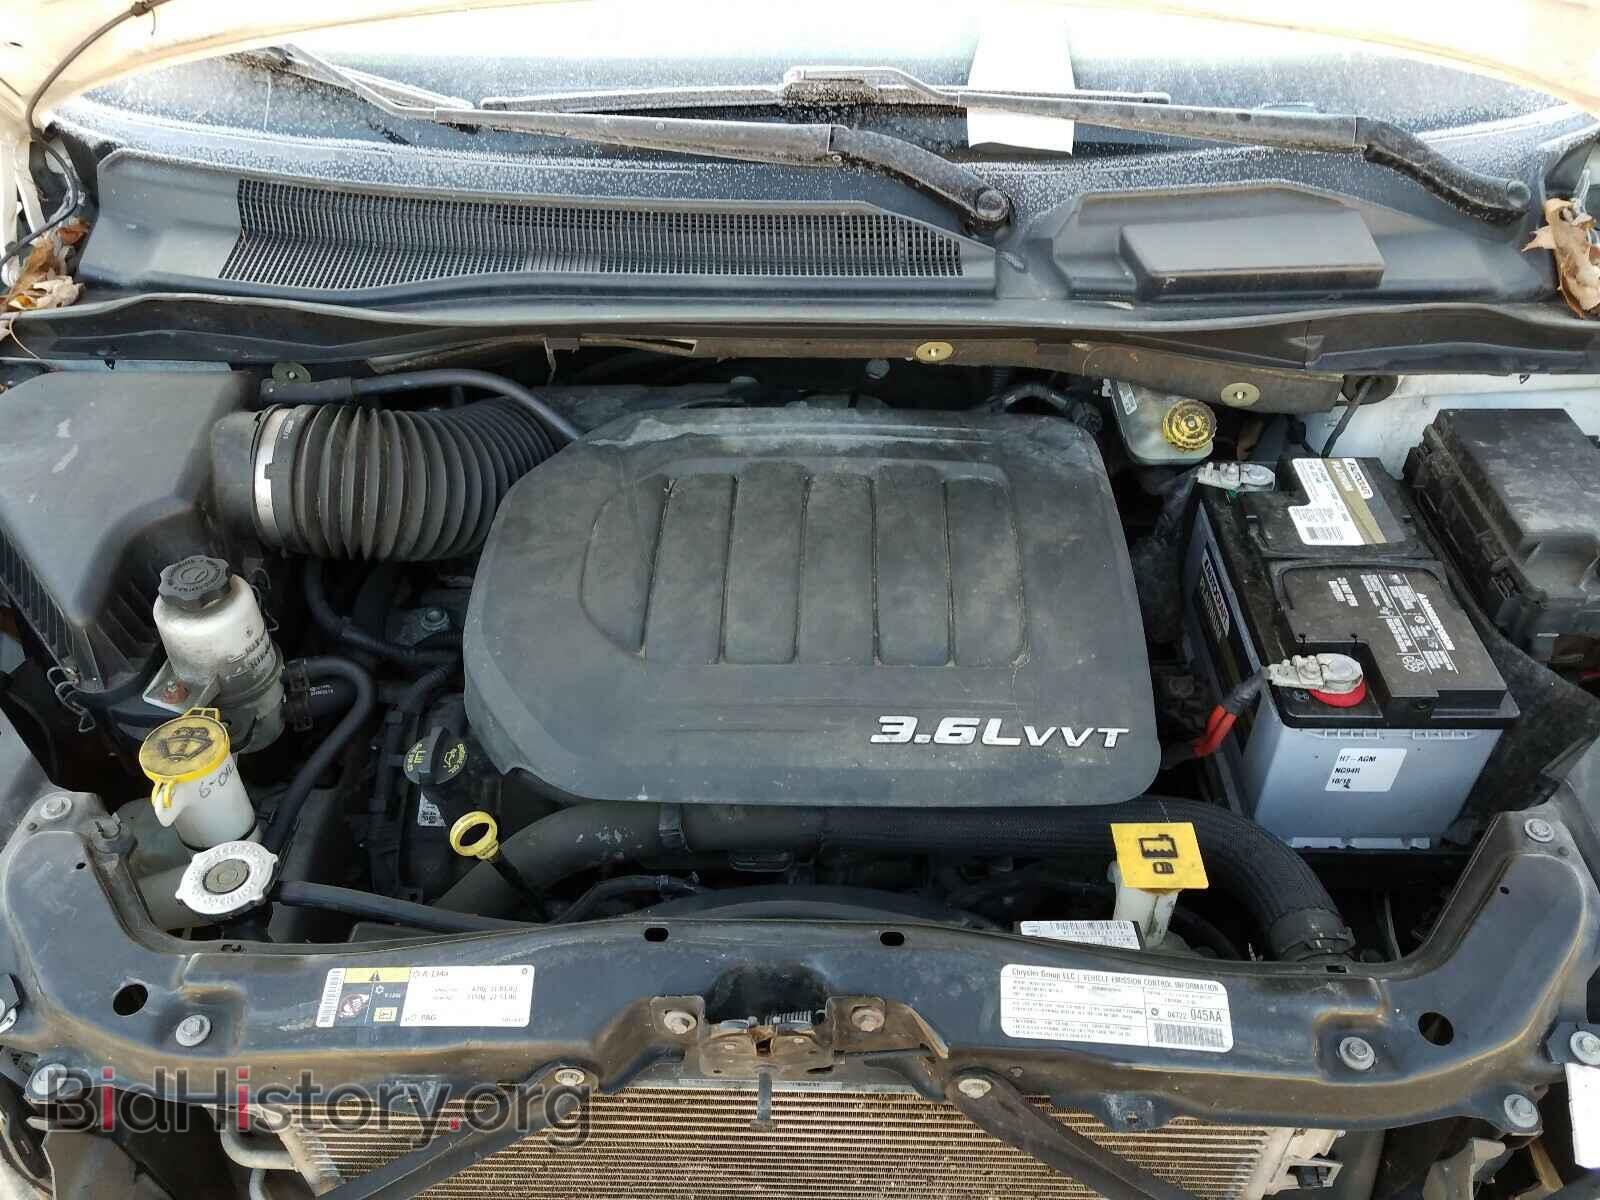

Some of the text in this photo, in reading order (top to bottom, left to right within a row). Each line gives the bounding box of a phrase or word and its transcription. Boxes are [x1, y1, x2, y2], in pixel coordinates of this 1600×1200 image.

[1012, 967, 1219, 992] Chrysler Group LLC VEHICLE EMISSION CONTROL INFORMATION
